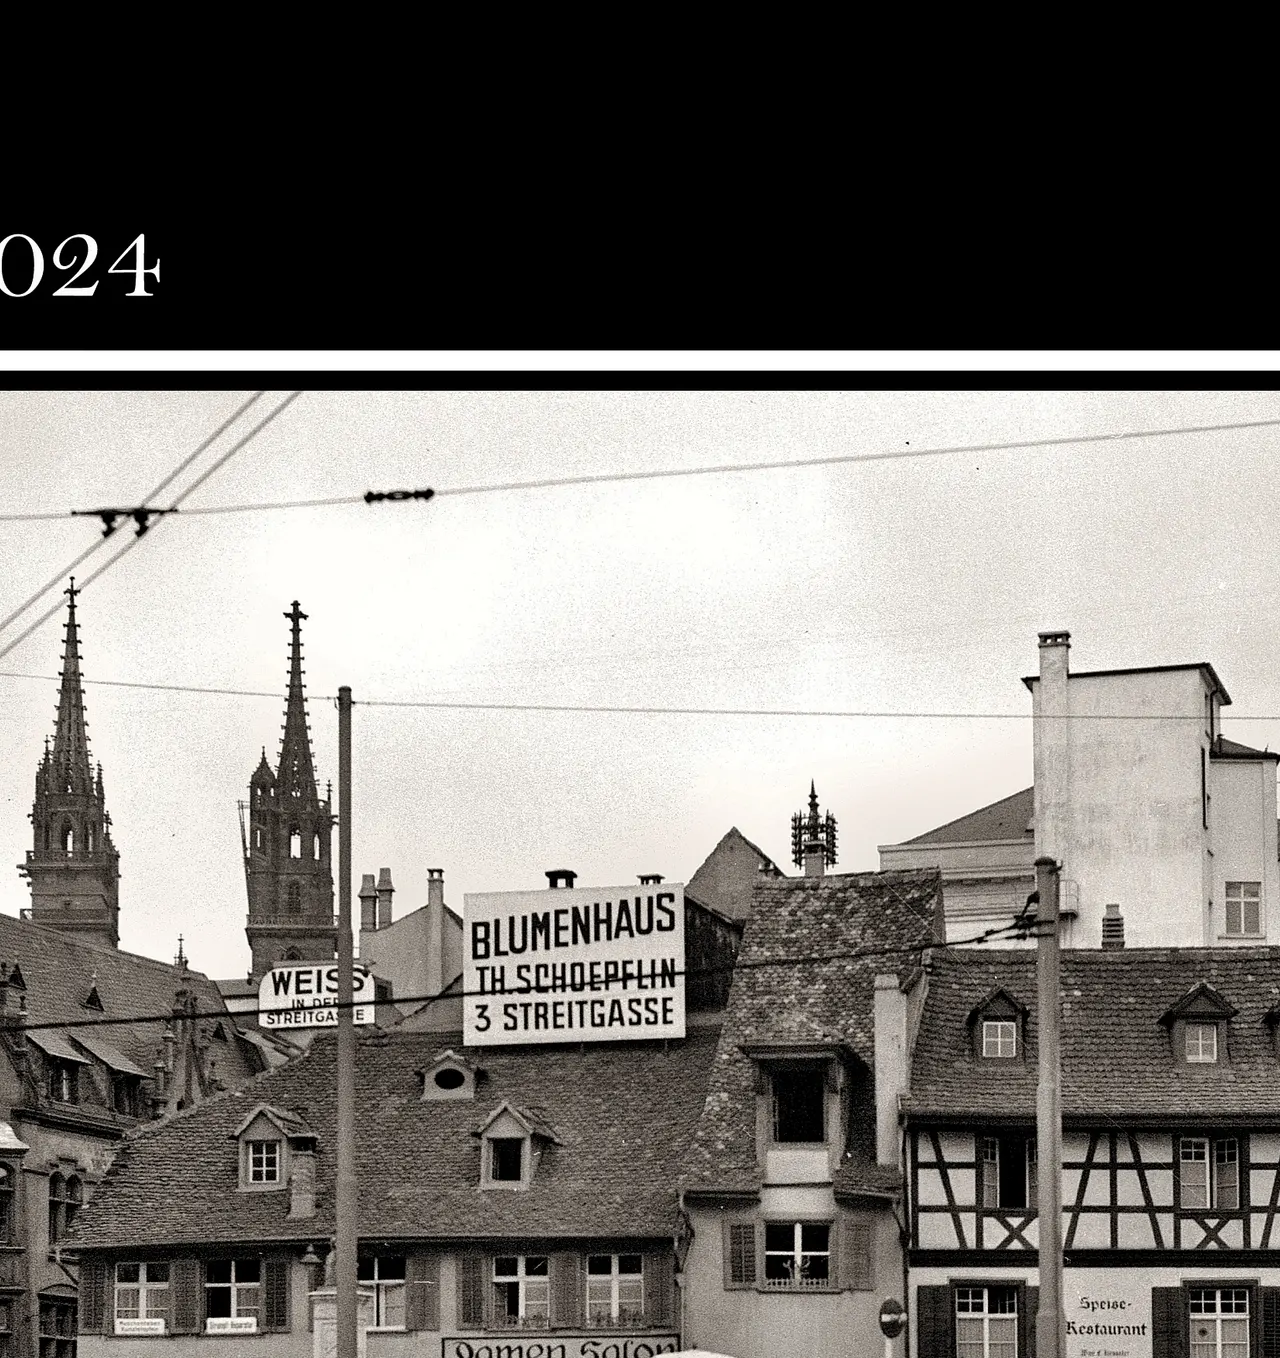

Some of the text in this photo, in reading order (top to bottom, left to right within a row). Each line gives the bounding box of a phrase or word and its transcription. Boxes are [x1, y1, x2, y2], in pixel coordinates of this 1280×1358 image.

[472, 892, 675, 960] BLUMENHAUS
[292, 998, 305, 1009] IN
[267, 1009, 365, 1025] STREITGAE
[475, 997, 674, 1032] 3 STREITGASSE
[1080, 1296, 1133, 1312] Speise-
[1066, 1320, 1148, 1336] Restaurant
